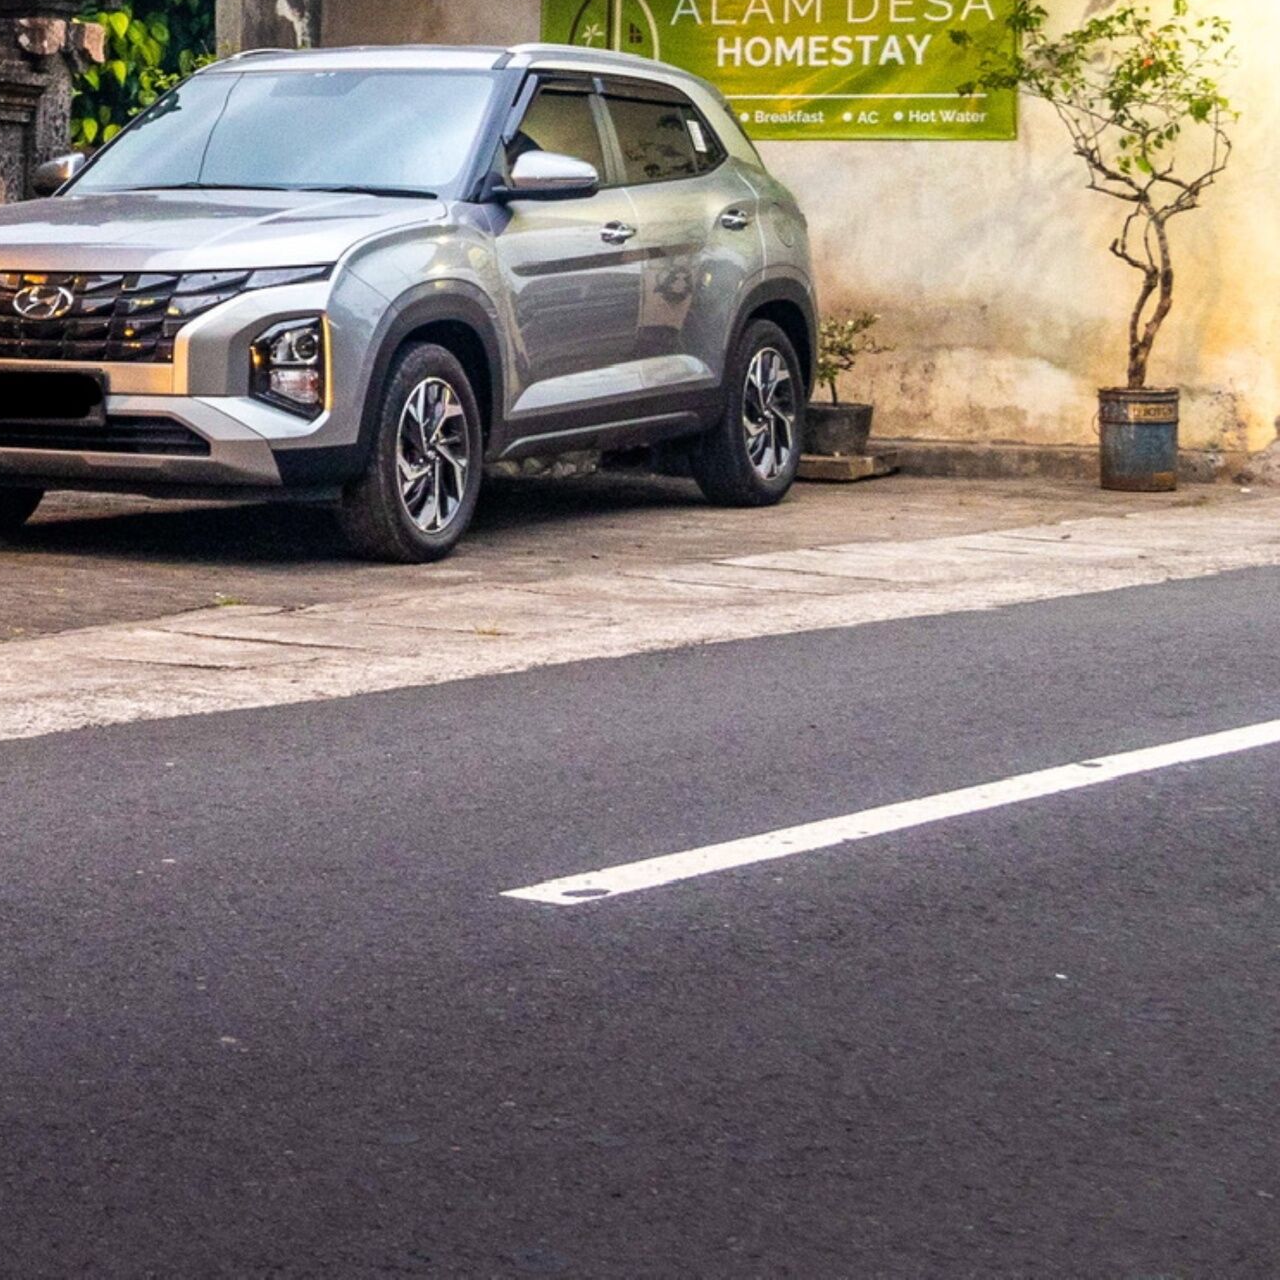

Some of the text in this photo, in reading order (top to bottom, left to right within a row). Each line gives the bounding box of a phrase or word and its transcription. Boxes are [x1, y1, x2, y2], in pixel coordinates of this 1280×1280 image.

[716, 33, 932, 67] HOMESTAY
[754, 110, 987, 124] Breakfast AC Hot Water
